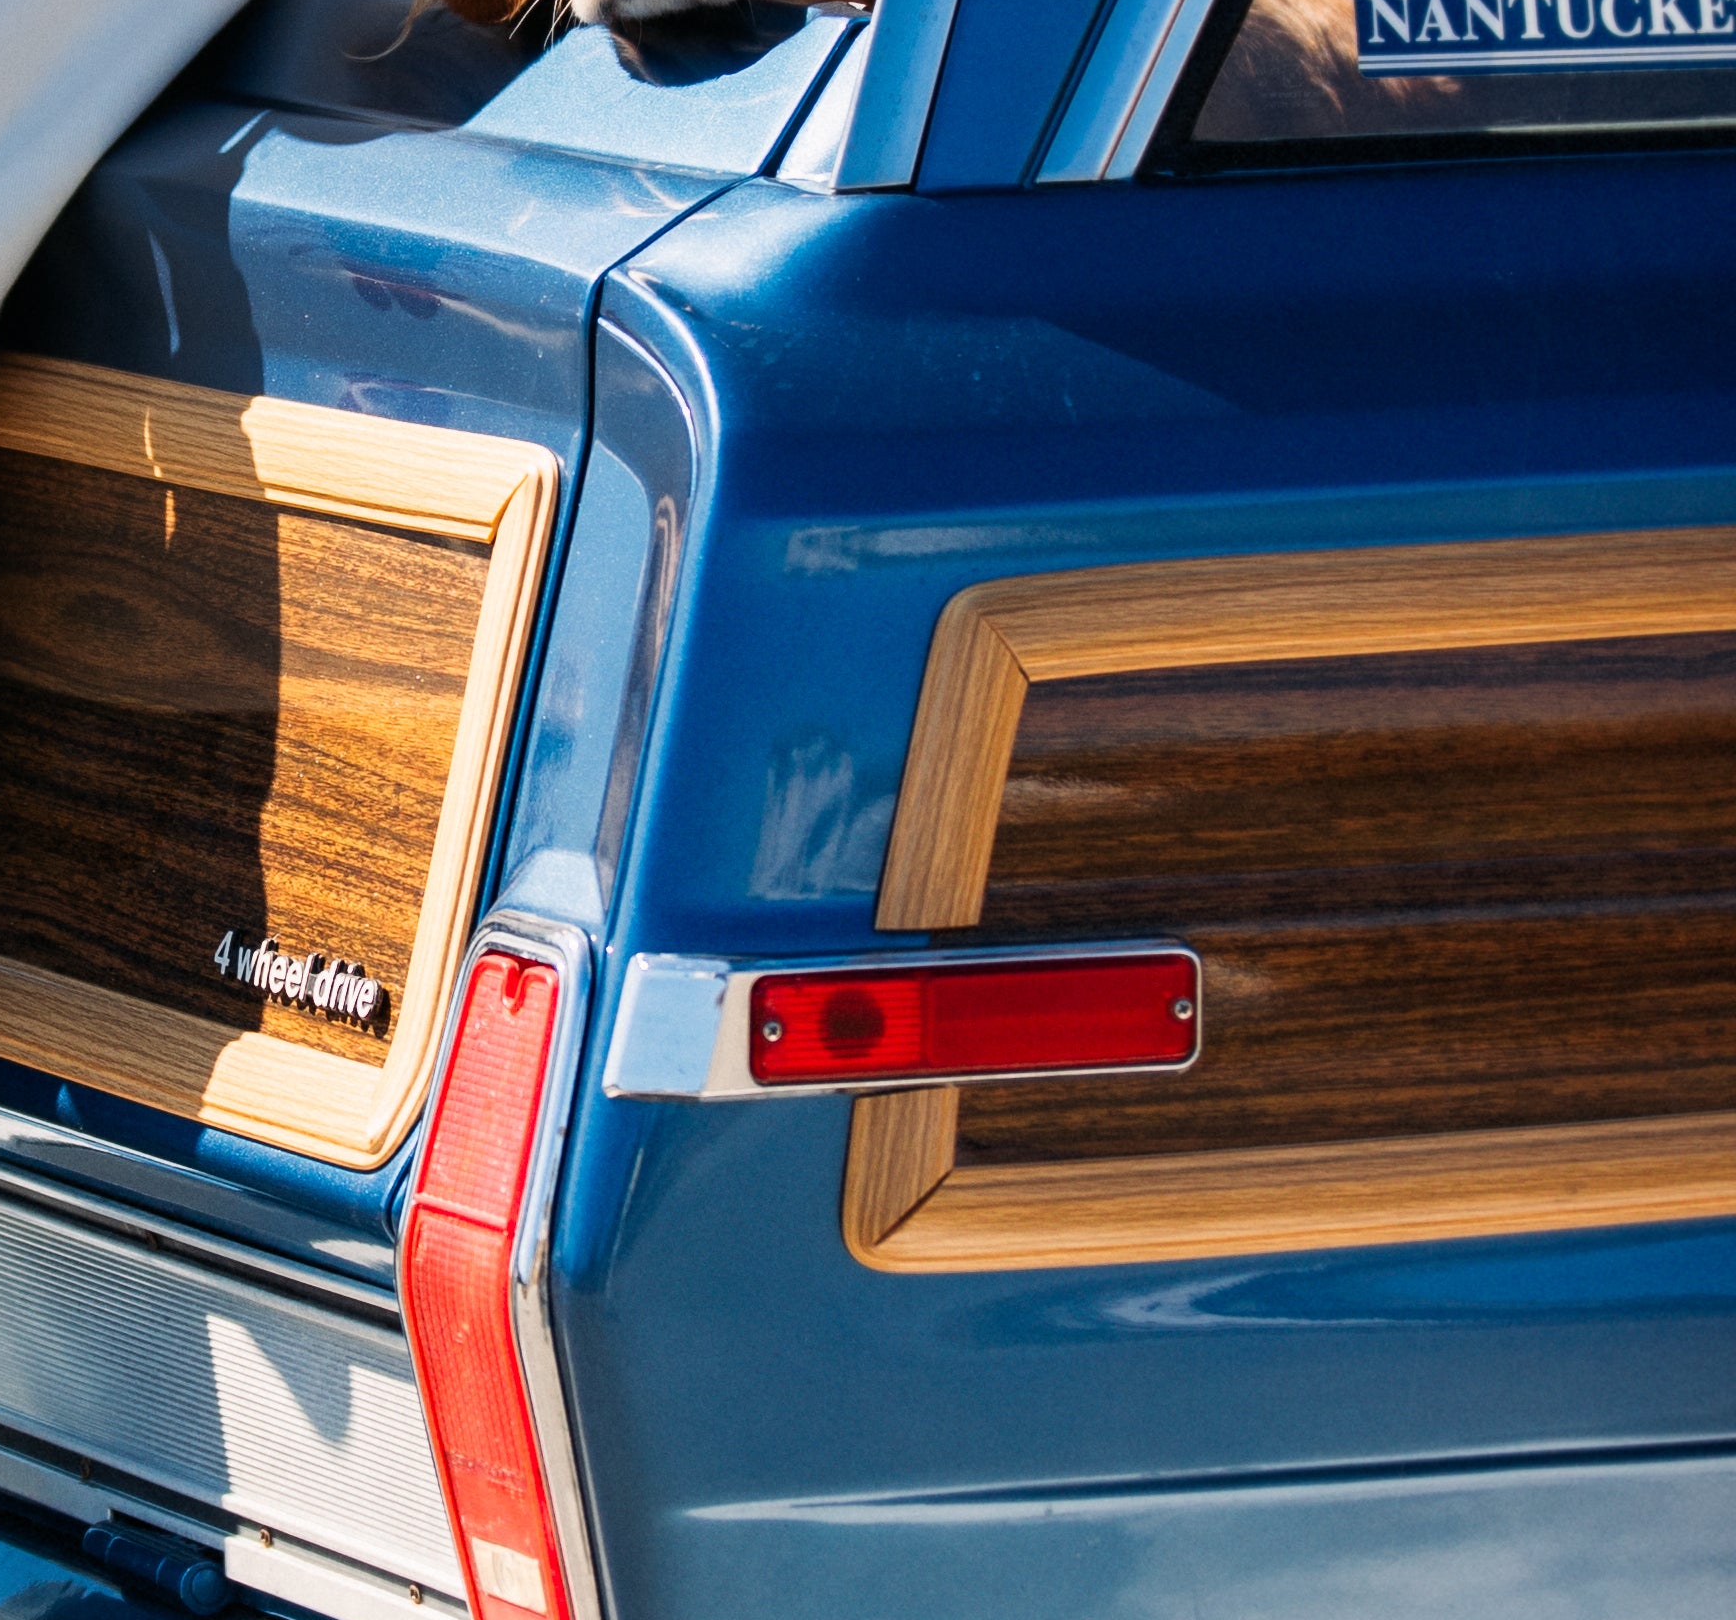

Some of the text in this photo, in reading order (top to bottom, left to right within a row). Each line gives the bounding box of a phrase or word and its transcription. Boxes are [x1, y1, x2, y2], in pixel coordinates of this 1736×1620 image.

[214, 930, 380, 1020] 4 wheel drive
